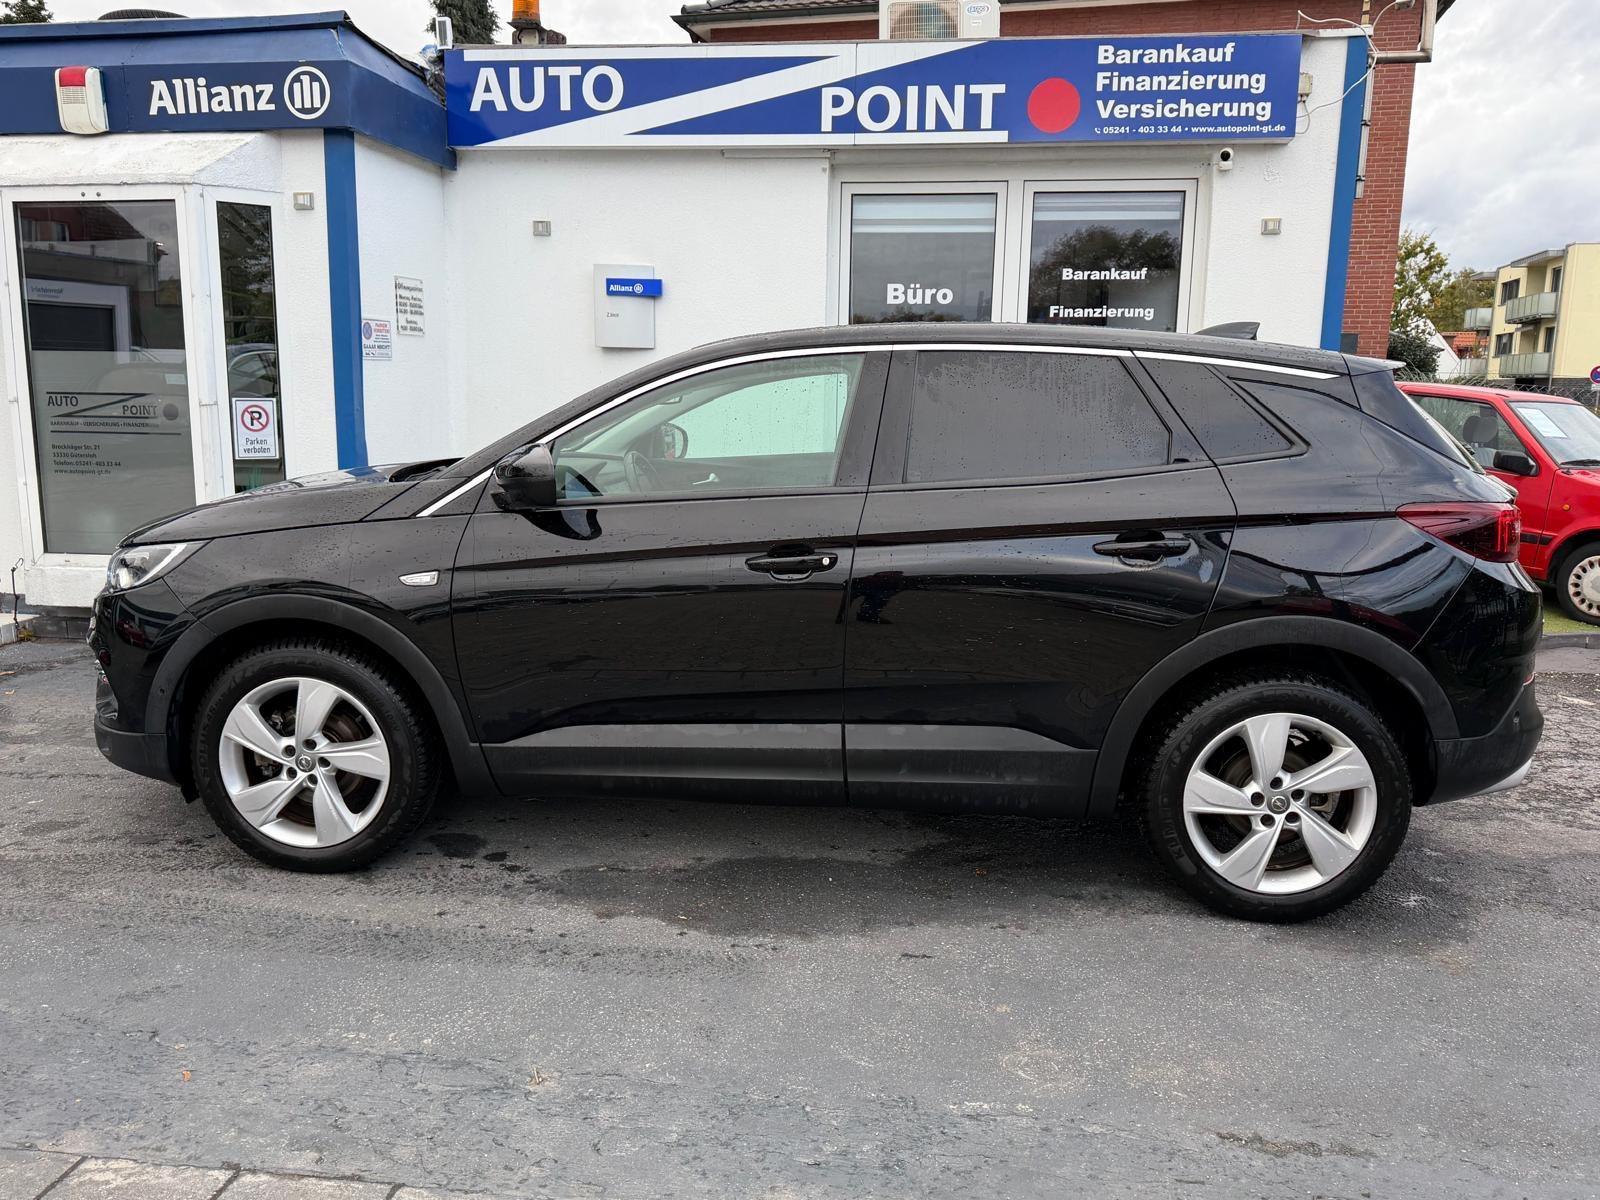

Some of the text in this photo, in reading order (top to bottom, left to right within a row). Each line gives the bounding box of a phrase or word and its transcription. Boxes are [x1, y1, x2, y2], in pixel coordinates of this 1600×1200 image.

[1097, 42, 1236, 65] Barankauf
[469, 65, 624, 112] AUTO
[1096, 70, 1266, 94] Finanzierung
[149, 76, 276, 116] Allianz
[820, 83, 1006, 132] POINT
[1096, 98, 1272, 122] Versicherung
[1103, 126, 1130, 134] 05241
[1137, 126, 1155, 134] 403
[1157, 125, 1168, 133] 33
[1170, 125, 1182, 133] 44
[1191, 124, 1286, 133] www.autopoint-gt.de
[1061, 267, 1148, 281] Barankauf
[608, 284, 633, 292] Allianz
[886, 283, 954, 305] Büro
[1049, 305, 1155, 320] Finanzierung
[47, 395, 79, 407] AUTO
[122, 405, 158, 416] POINT
[245, 437, 268, 446] Parken
[243, 446, 271, 454] verboten
